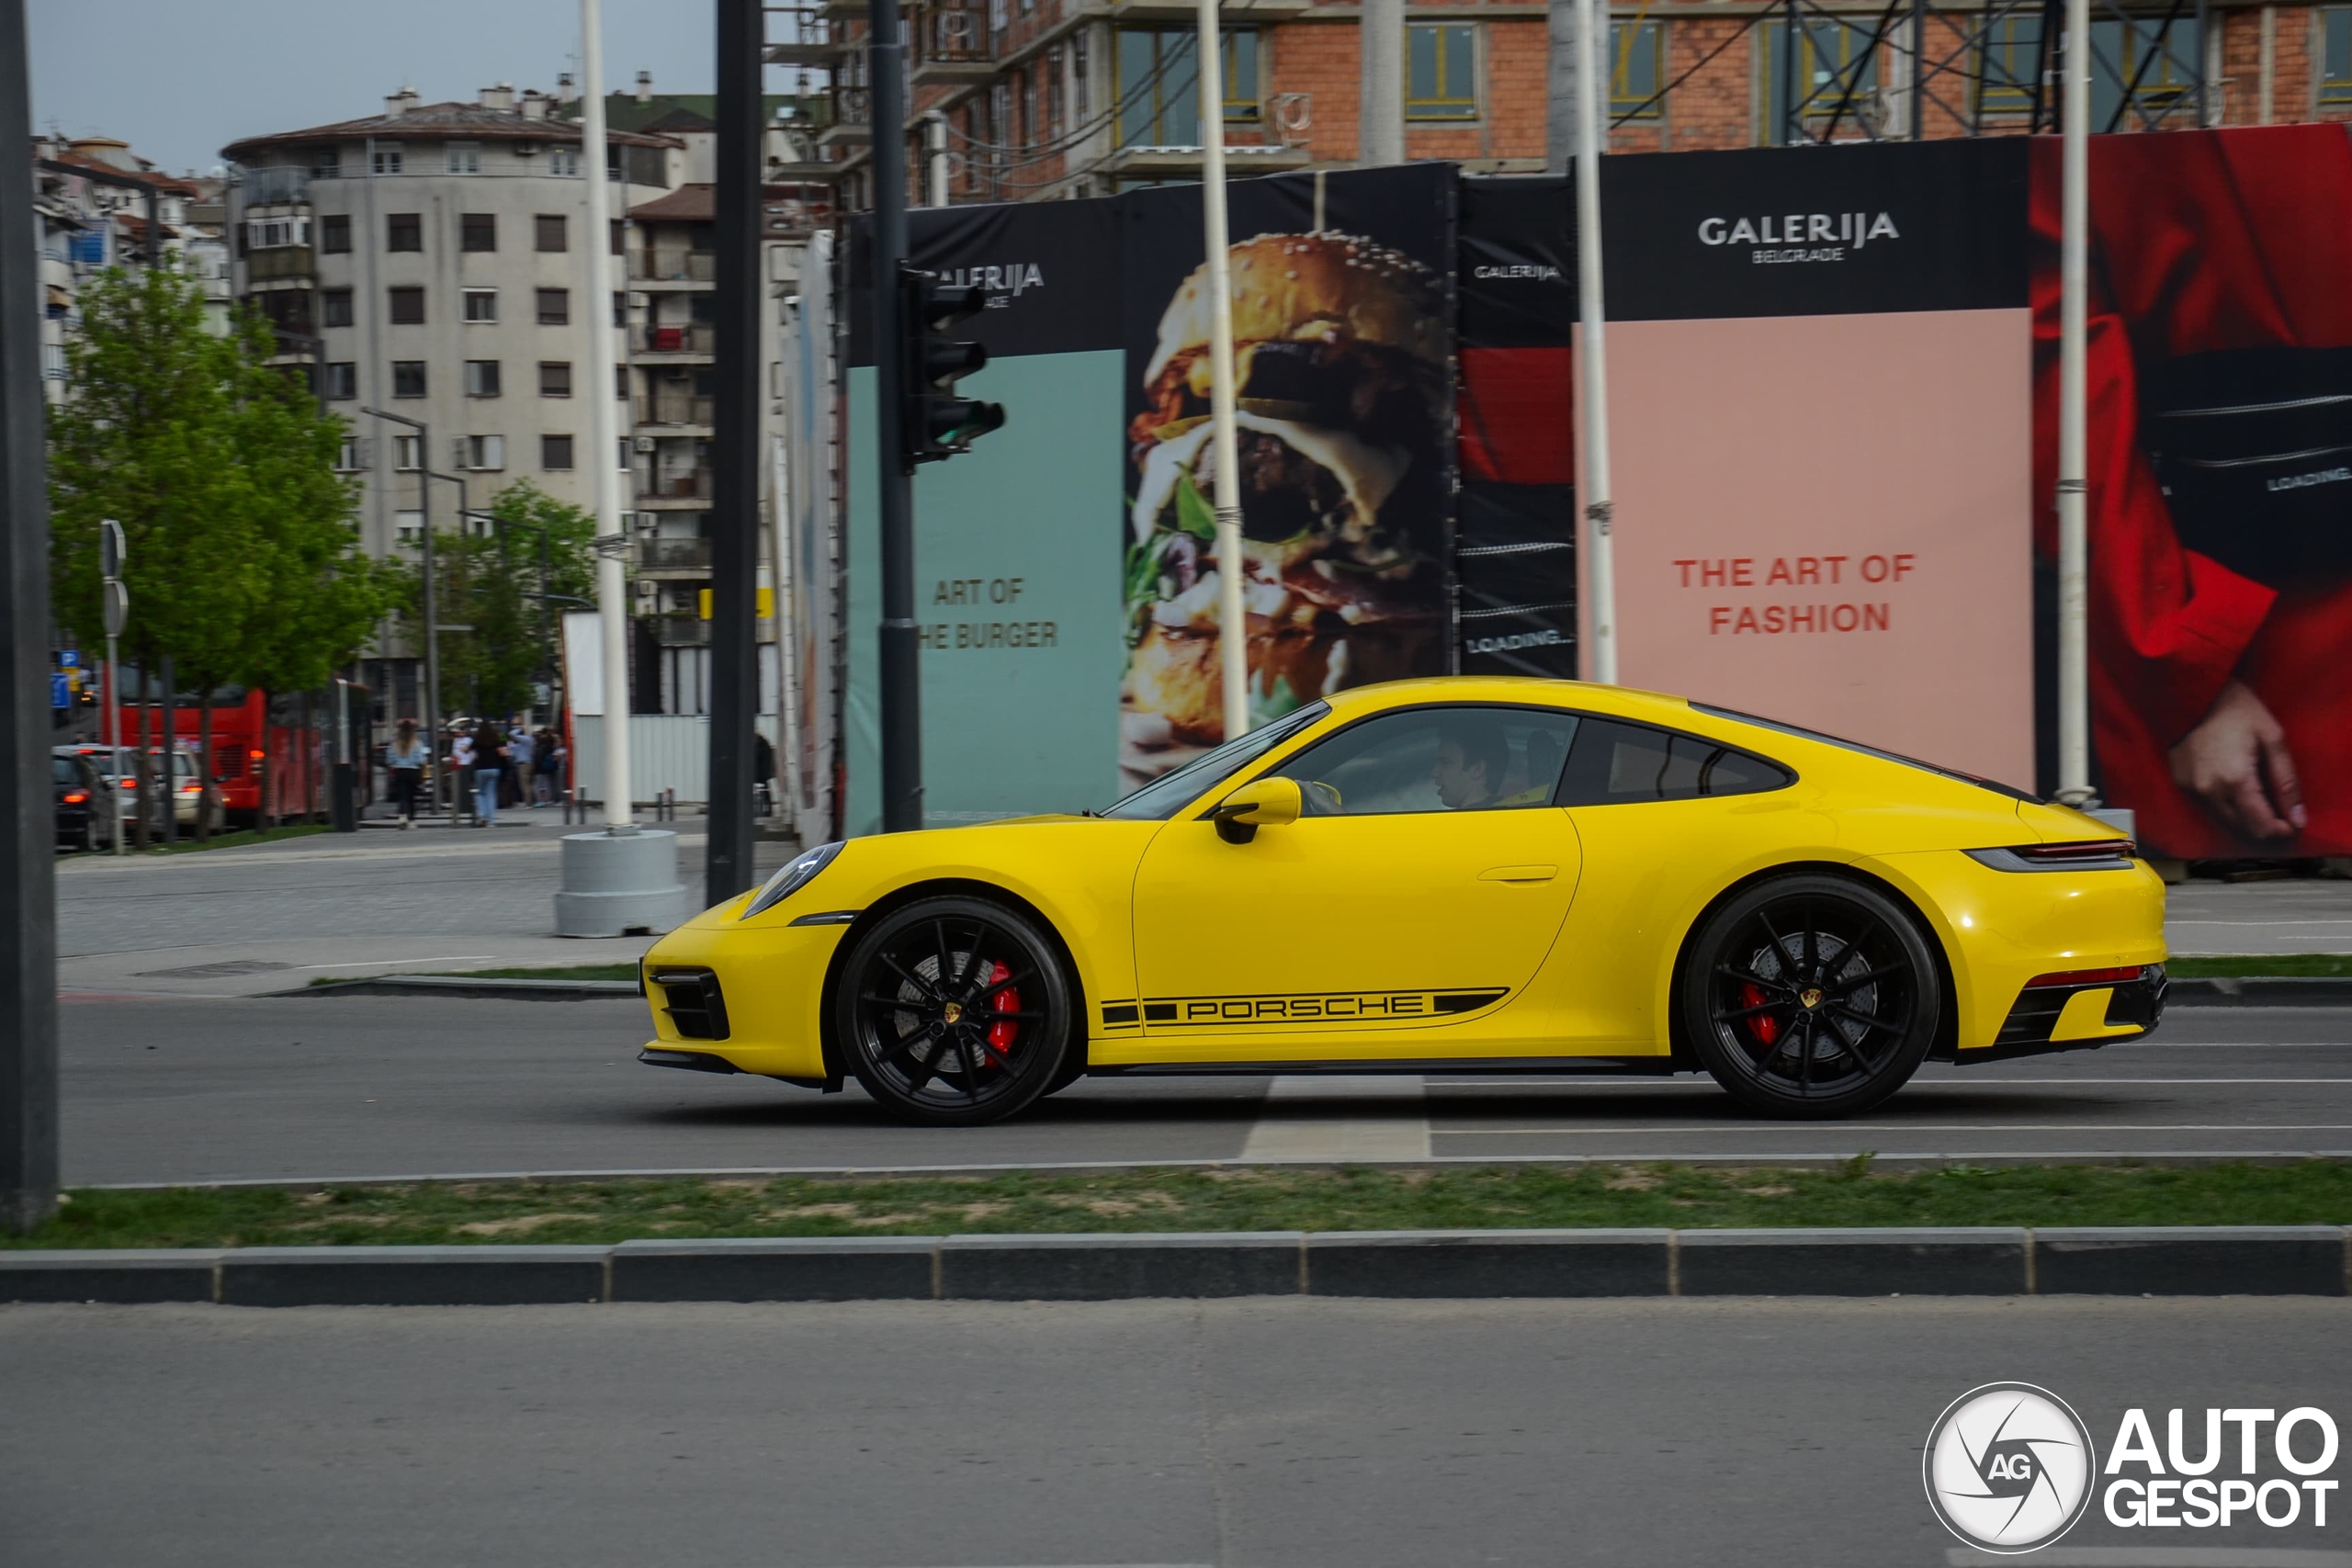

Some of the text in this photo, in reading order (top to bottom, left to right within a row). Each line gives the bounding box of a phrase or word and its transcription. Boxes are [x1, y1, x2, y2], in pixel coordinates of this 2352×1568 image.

[1698, 212, 1900, 249] GALERIJA
[1752, 247, 1845, 264] BELGRADE
[1474, 265, 1561, 281] GALERIJA
[1671, 553, 1917, 588] THE ART OF
[933, 577, 1024, 605] ART OF
[1709, 603, 1890, 635] FASHION
[918, 621, 1058, 649] HE BURGER
[1187, 996, 1423, 1021] PORSCHE
